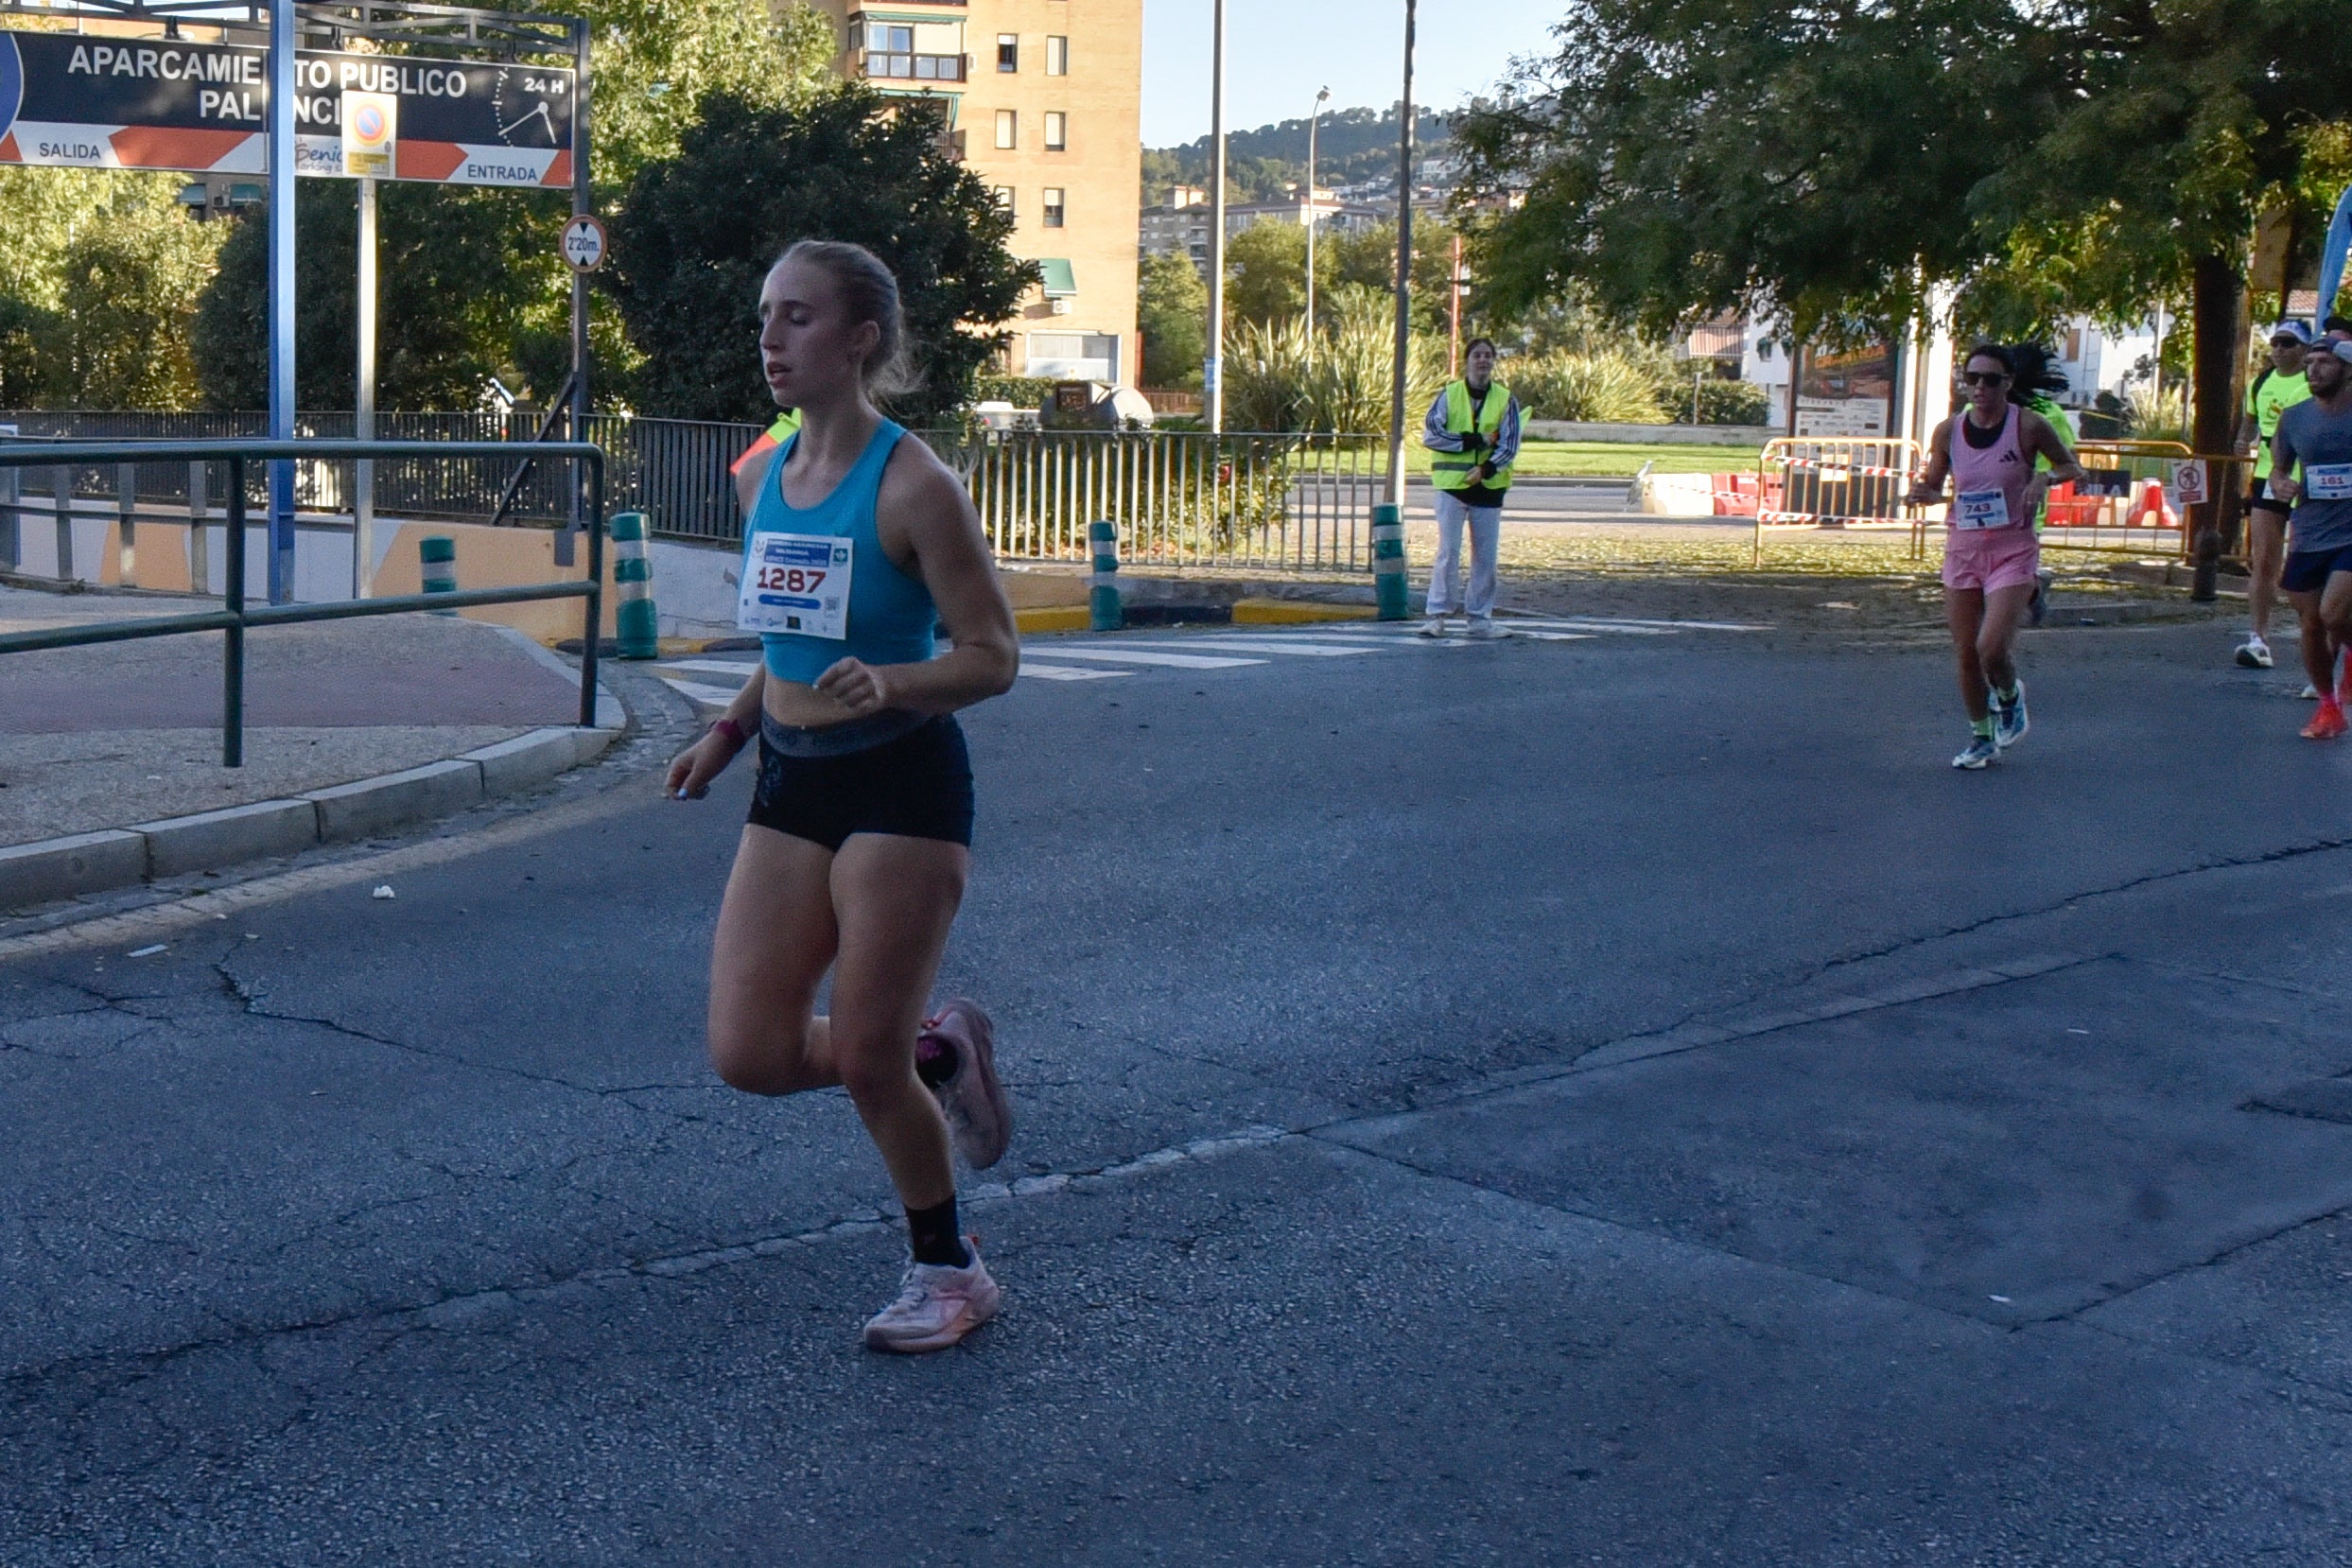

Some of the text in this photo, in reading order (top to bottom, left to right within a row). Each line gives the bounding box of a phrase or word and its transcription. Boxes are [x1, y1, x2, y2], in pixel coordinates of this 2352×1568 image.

[67, 45, 467, 98] APARCAMIETO PUBLICO
[524, 78, 565, 94] 24 H
[200, 90, 340, 125] PALNCI
[39, 142, 101, 159] SALIDA
[467, 164, 538, 182] ENTRADA
[757, 567, 827, 594] 1287
